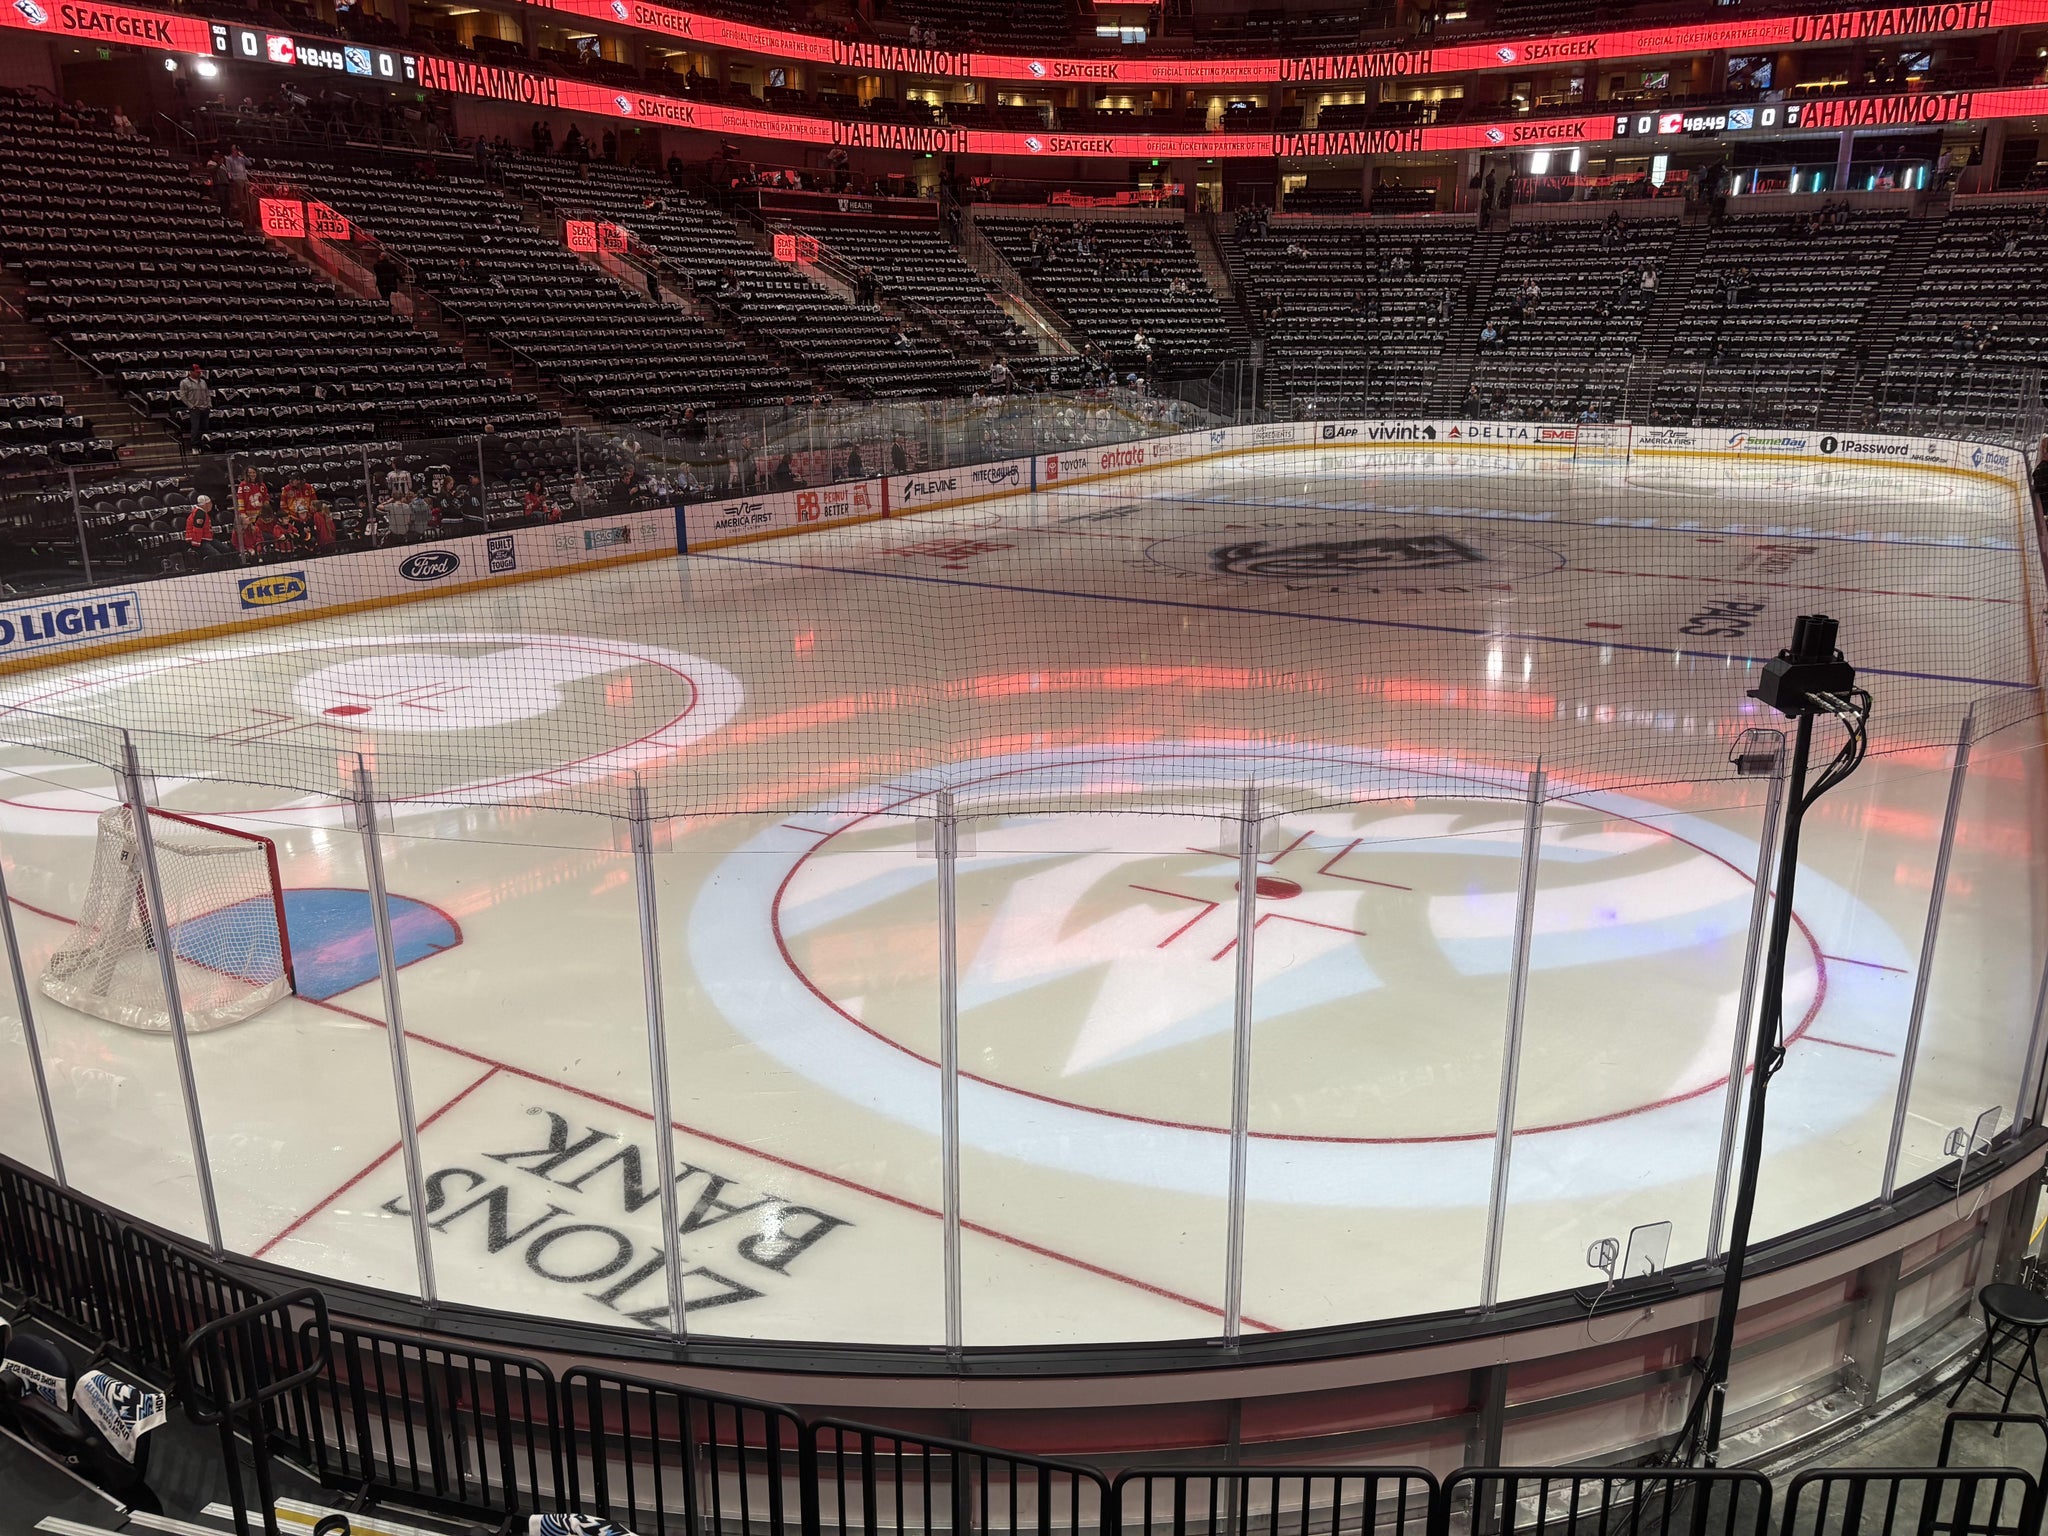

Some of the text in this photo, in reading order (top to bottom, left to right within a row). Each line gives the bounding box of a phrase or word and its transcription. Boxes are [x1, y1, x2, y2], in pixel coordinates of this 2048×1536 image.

[61, 4, 174, 45] SEATGEEK
[635, 5, 693, 35] SEATGEEK
[1792, 1, 1992, 42] UTAH MAMMOTH
[216, 36, 226, 51] 0
[241, 32, 258, 56] 0
[722, 28, 830, 55] OFFICIAL TICKETING PARTNER OF THE
[1637, 25, 1789, 47] OFFICIAL TICKETING PARTNER OF THE
[296, 47, 344, 70] 48:49
[832, 40, 970, 77] UTAH MAMMOTH
[1524, 39, 1599, 61] SEATGEEK
[379, 54, 393, 76] 0
[406, 65, 415, 78] 0
[1054, 62, 1119, 79] SEATGEEK
[1152, 67, 1277, 76] OFFICIAL TICKETING PARTNER OF THE
[1279, 51, 1432, 81] UTAH MAMMOTH
[454, 62, 558, 107] MAMMOTH
[638, 98, 695, 124] SEATGEEK
[1761, 109, 1775, 125] 0
[1788, 113, 1797, 123] 0
[1841, 94, 1972, 126] MAMMOTH
[723, 115, 829, 135] OFFICIAL TICKETING PARTNER OF THE
[1512, 122, 1585, 141] SEATGEEK
[1618, 124, 1625, 134] 0
[1638, 117, 1650, 133] 0
[1683, 116, 1725, 132] 48:49
[832, 121, 968, 153] UTAH MAMMOTH
[1050, 138, 1114, 153] SEATGEEK
[1272, 129, 1423, 156] UTAH MAMMOTH
[1147, 142, 1269, 150] OFFICIAL TICKETING PARTNER OF THE
[268, 205, 295, 218] SEAT
[850, 202, 872, 210] HEALTH
[268, 218, 298, 230] GEEK
[572, 226, 591, 237] SEAT
[572, 236, 592, 247] GEEK
[1469, 427, 1528, 439] DELTA
[1542, 430, 1575, 440] SME
[1747, 436, 1807, 449] SameDay
[1841, 440, 1909, 455] 1Password
[1060, 458, 1087, 471] TOYOTA
[1101, 447, 1144, 469] entrata
[914, 479, 957, 496] FILEVINE
[824, 490, 848, 503] PEANUT
[824, 503, 848, 517] BETTER
[715, 516, 750, 530] AMERICA
[751, 513, 772, 523] FIRST
[490, 538, 512, 550] BUILT
[555, 536, 575, 548] G2G
[410, 555, 450, 578] Ford
[491, 559, 513, 570] TOUGH
[246, 581, 302, 599] IKEA
[22, 600, 131, 642] LIGHT
[482, 1110, 856, 1277] BANK
[381, 1167, 767, 1332] ZIONS
